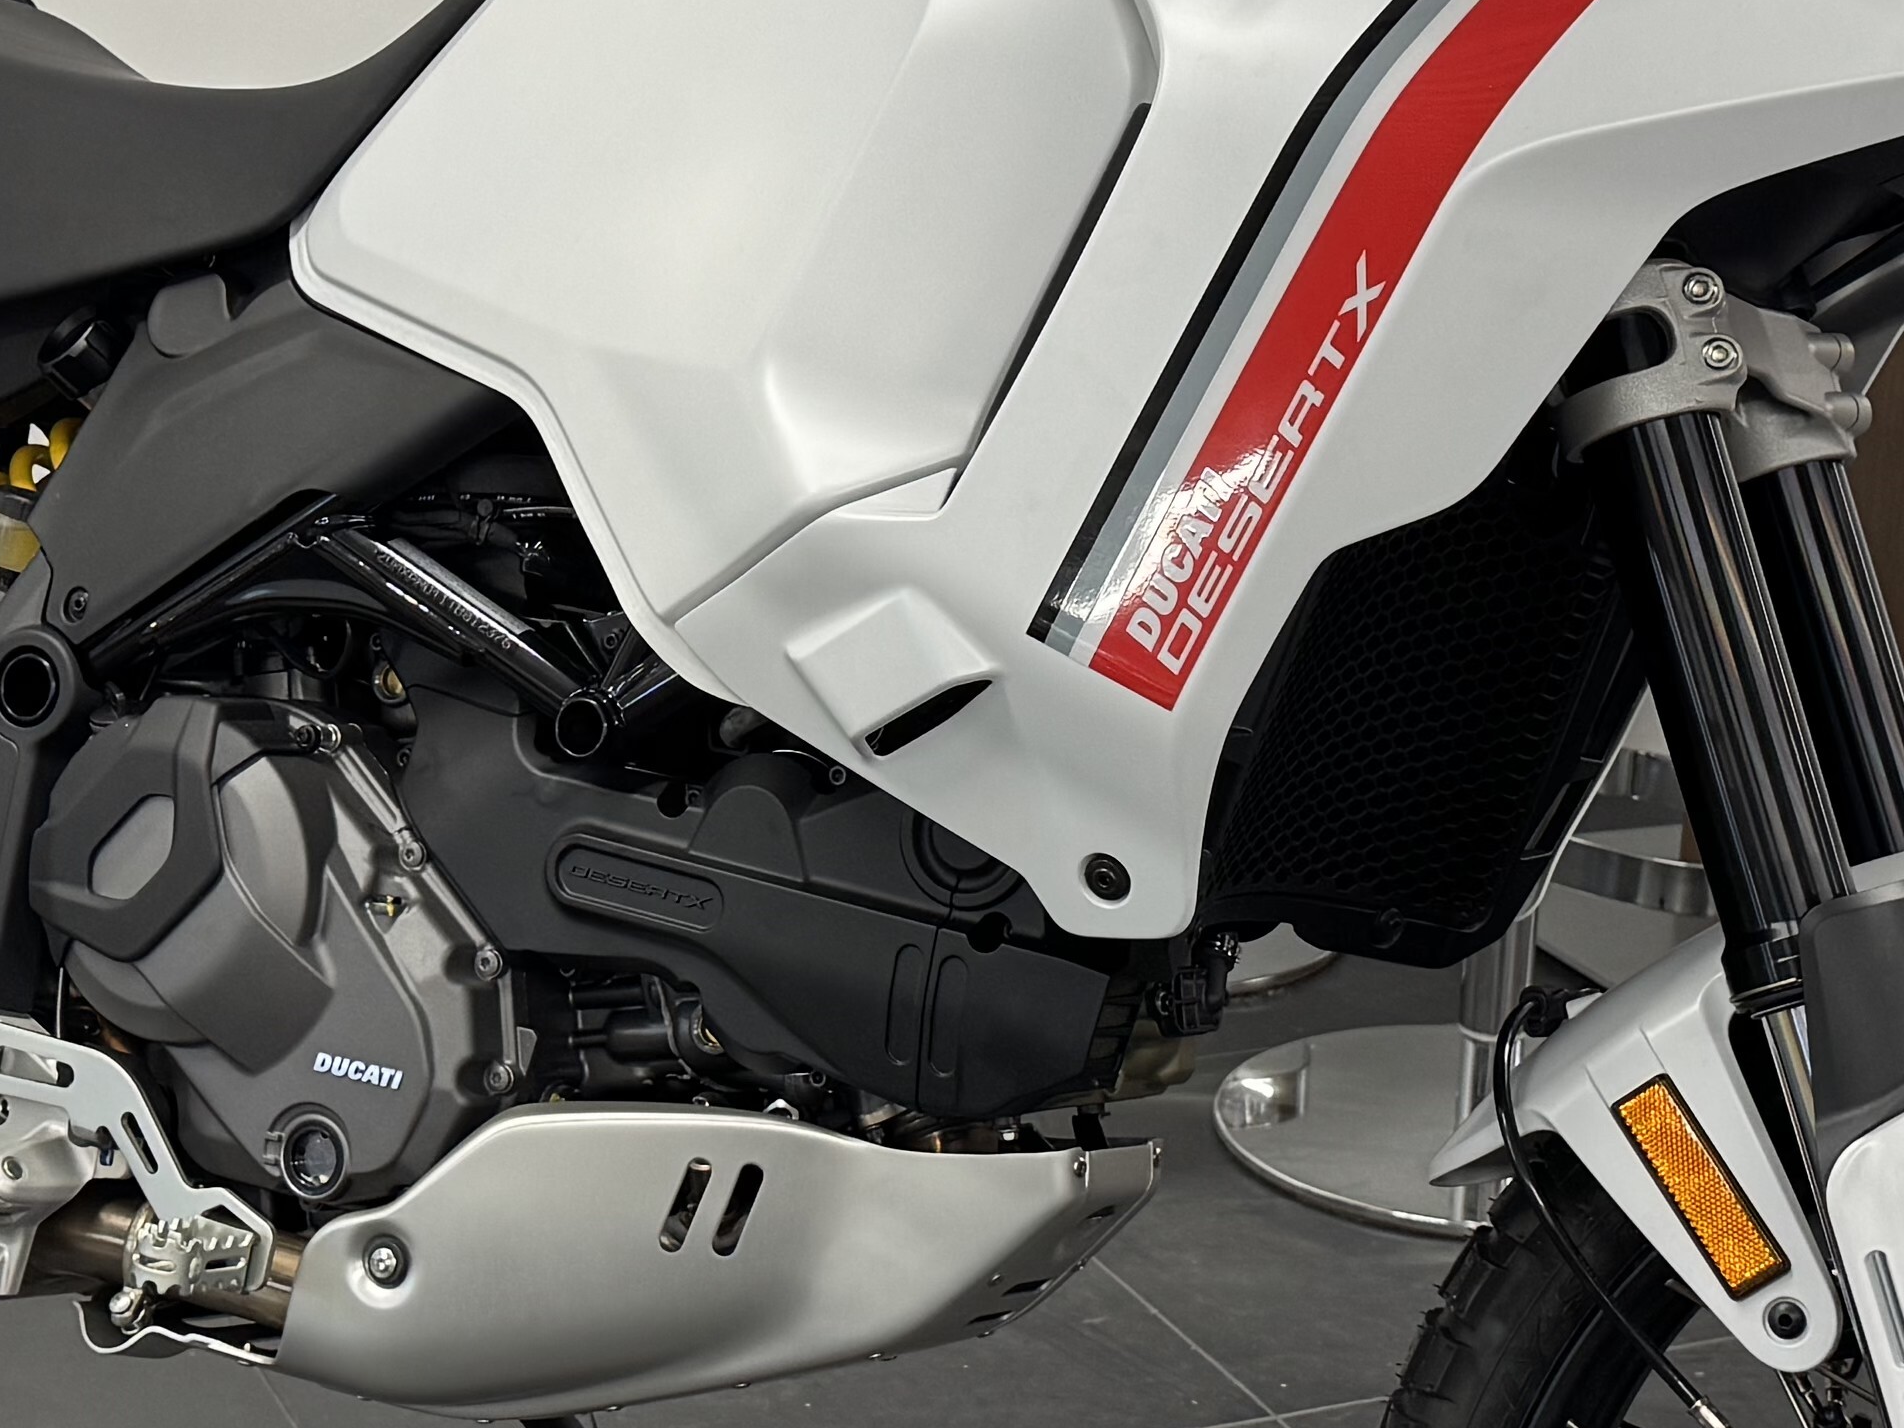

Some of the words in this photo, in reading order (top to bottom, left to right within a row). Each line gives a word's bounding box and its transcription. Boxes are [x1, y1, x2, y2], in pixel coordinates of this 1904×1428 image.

[1156, 248, 1387, 676] DESERTX
[1124, 466, 1223, 653] DUCATI
[312, 1051, 404, 1090] DUCATI
